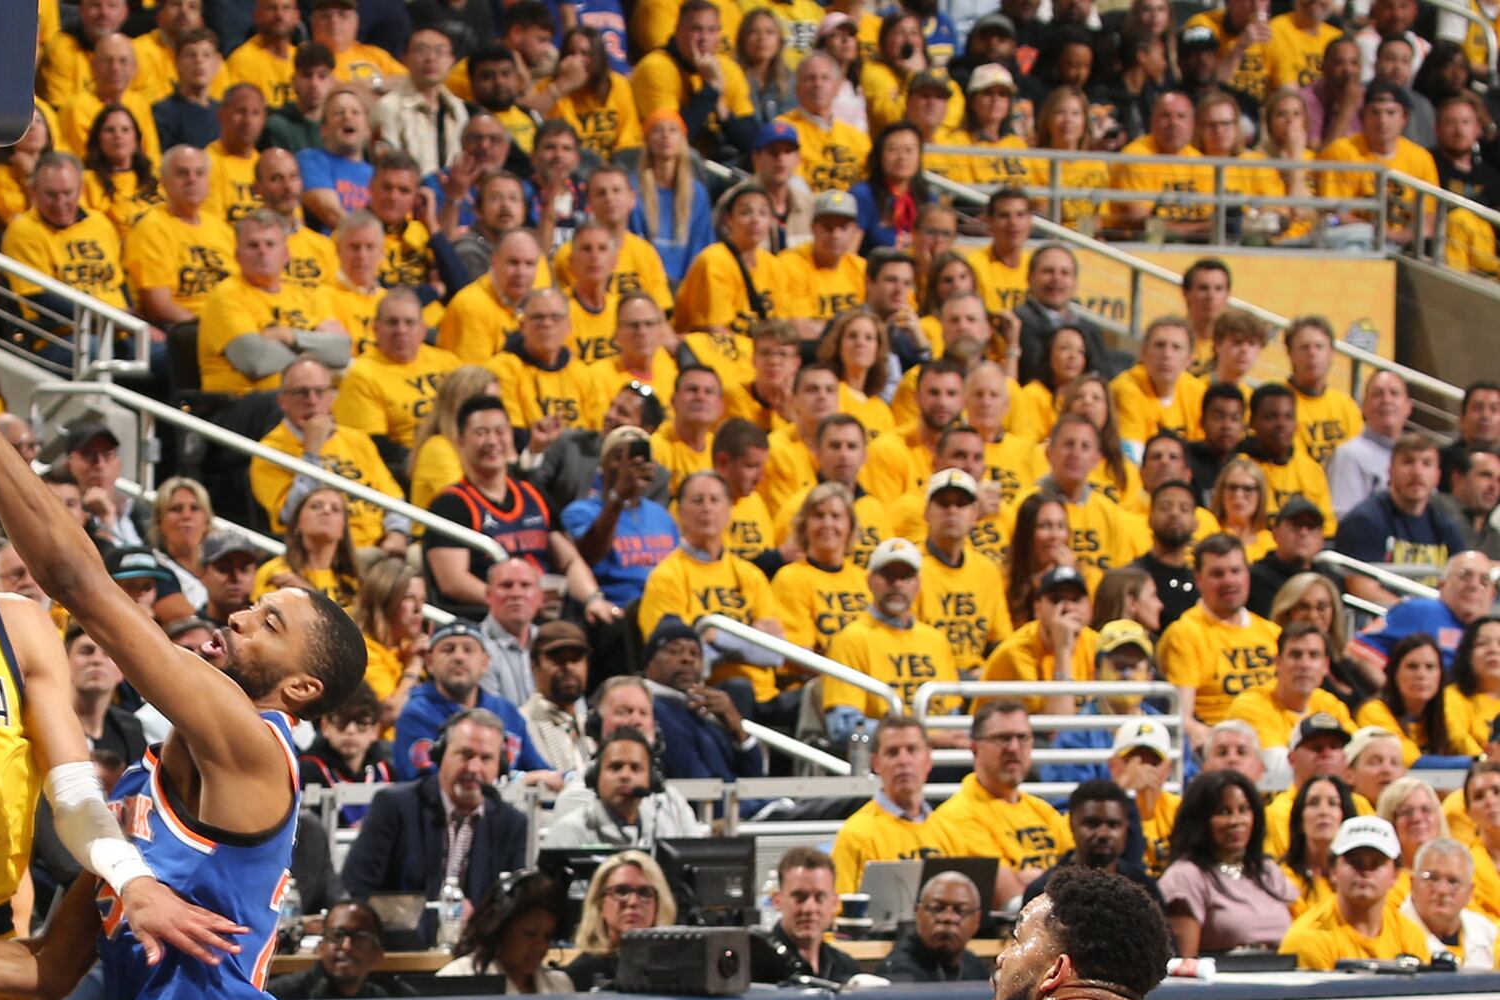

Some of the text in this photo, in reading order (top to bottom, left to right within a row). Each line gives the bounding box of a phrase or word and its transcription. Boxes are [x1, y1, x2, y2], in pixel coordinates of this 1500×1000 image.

[578, 111, 618, 132] YES
[64, 241, 105, 262] YES
[819, 294, 857, 315] YES
[576, 338, 621, 358] YES
[1307, 421, 1344, 440] YES
[730, 522, 762, 543] YES
[970, 525, 1000, 545] ES
[1073, 530, 1099, 552] ES
[692, 586, 746, 609] YES
[817, 590, 868, 612] YES
[940, 592, 977, 616] YES
[890, 654, 936, 677] YES
[1224, 646, 1274, 669] YES
